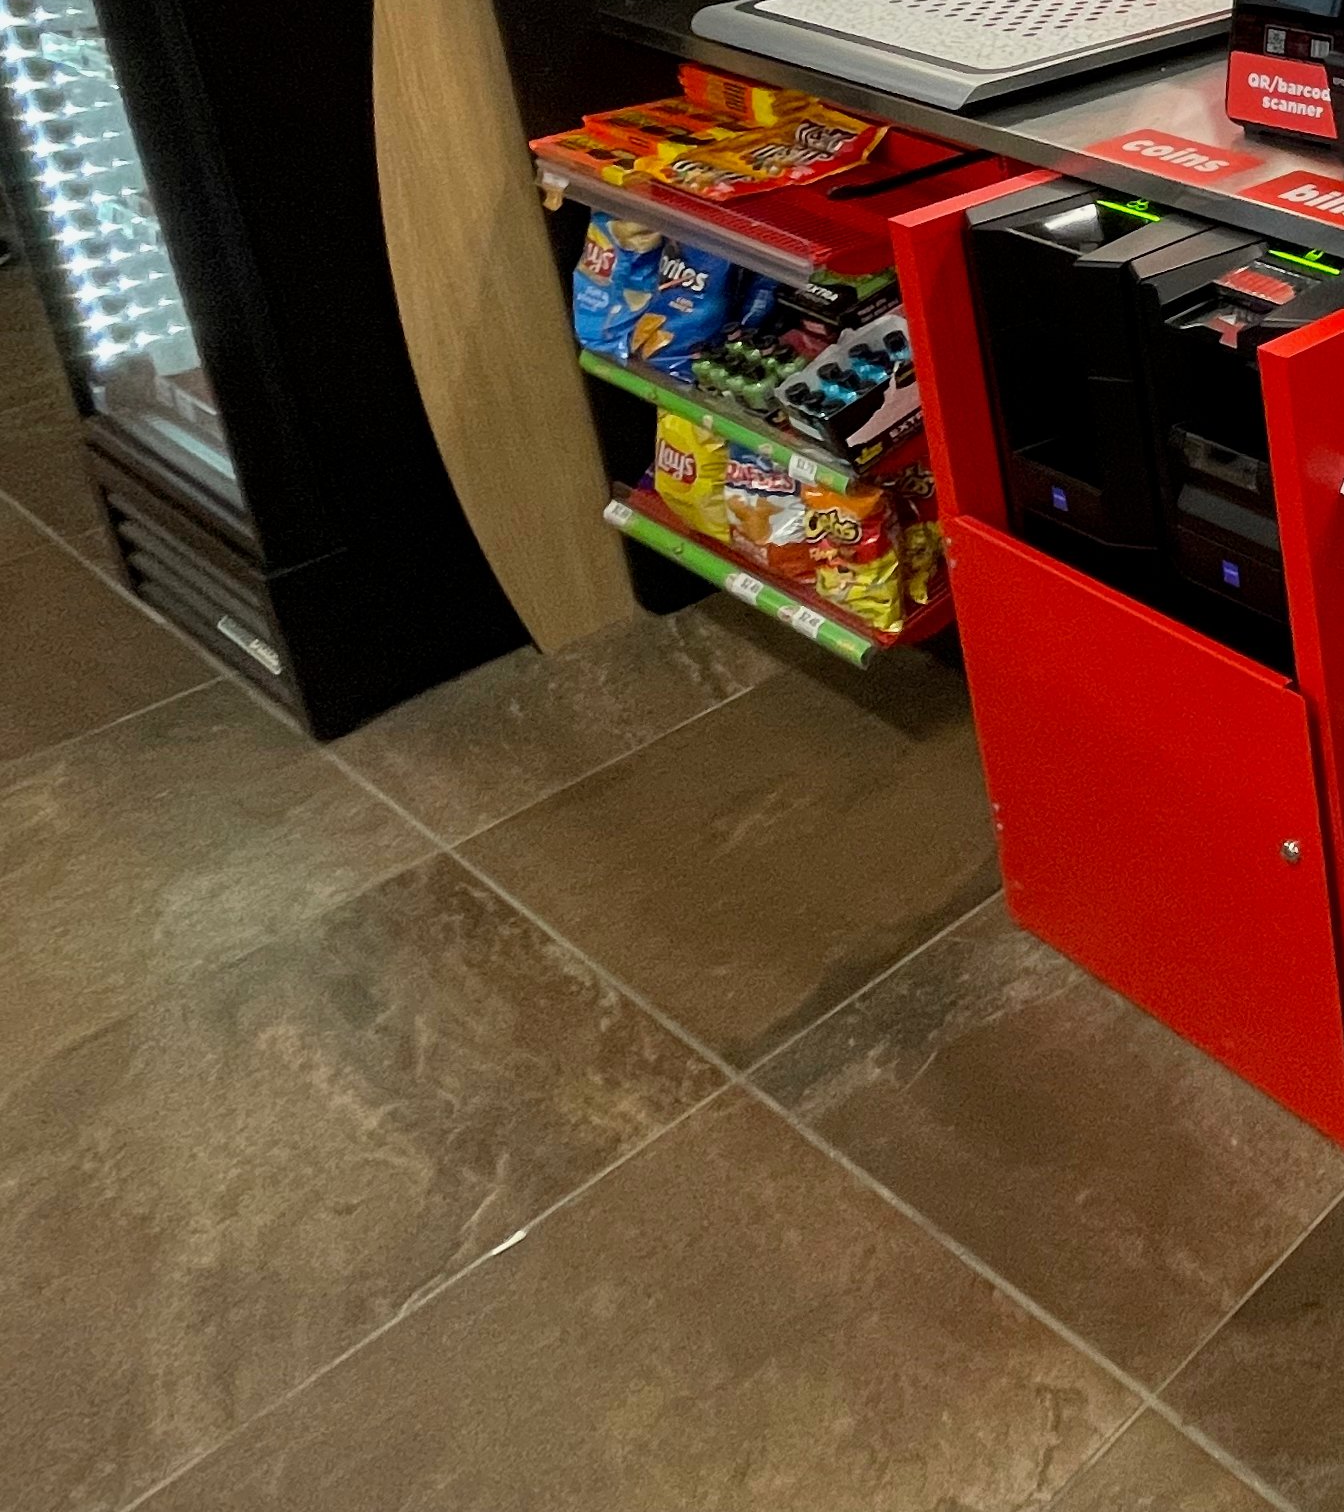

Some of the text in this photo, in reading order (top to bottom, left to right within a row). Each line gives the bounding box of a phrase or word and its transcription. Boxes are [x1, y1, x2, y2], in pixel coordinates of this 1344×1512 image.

[1247, 72, 1331, 102] QR/barcod
[1262, 96, 1324, 119] scanner
[1120, 135, 1230, 174] coins
